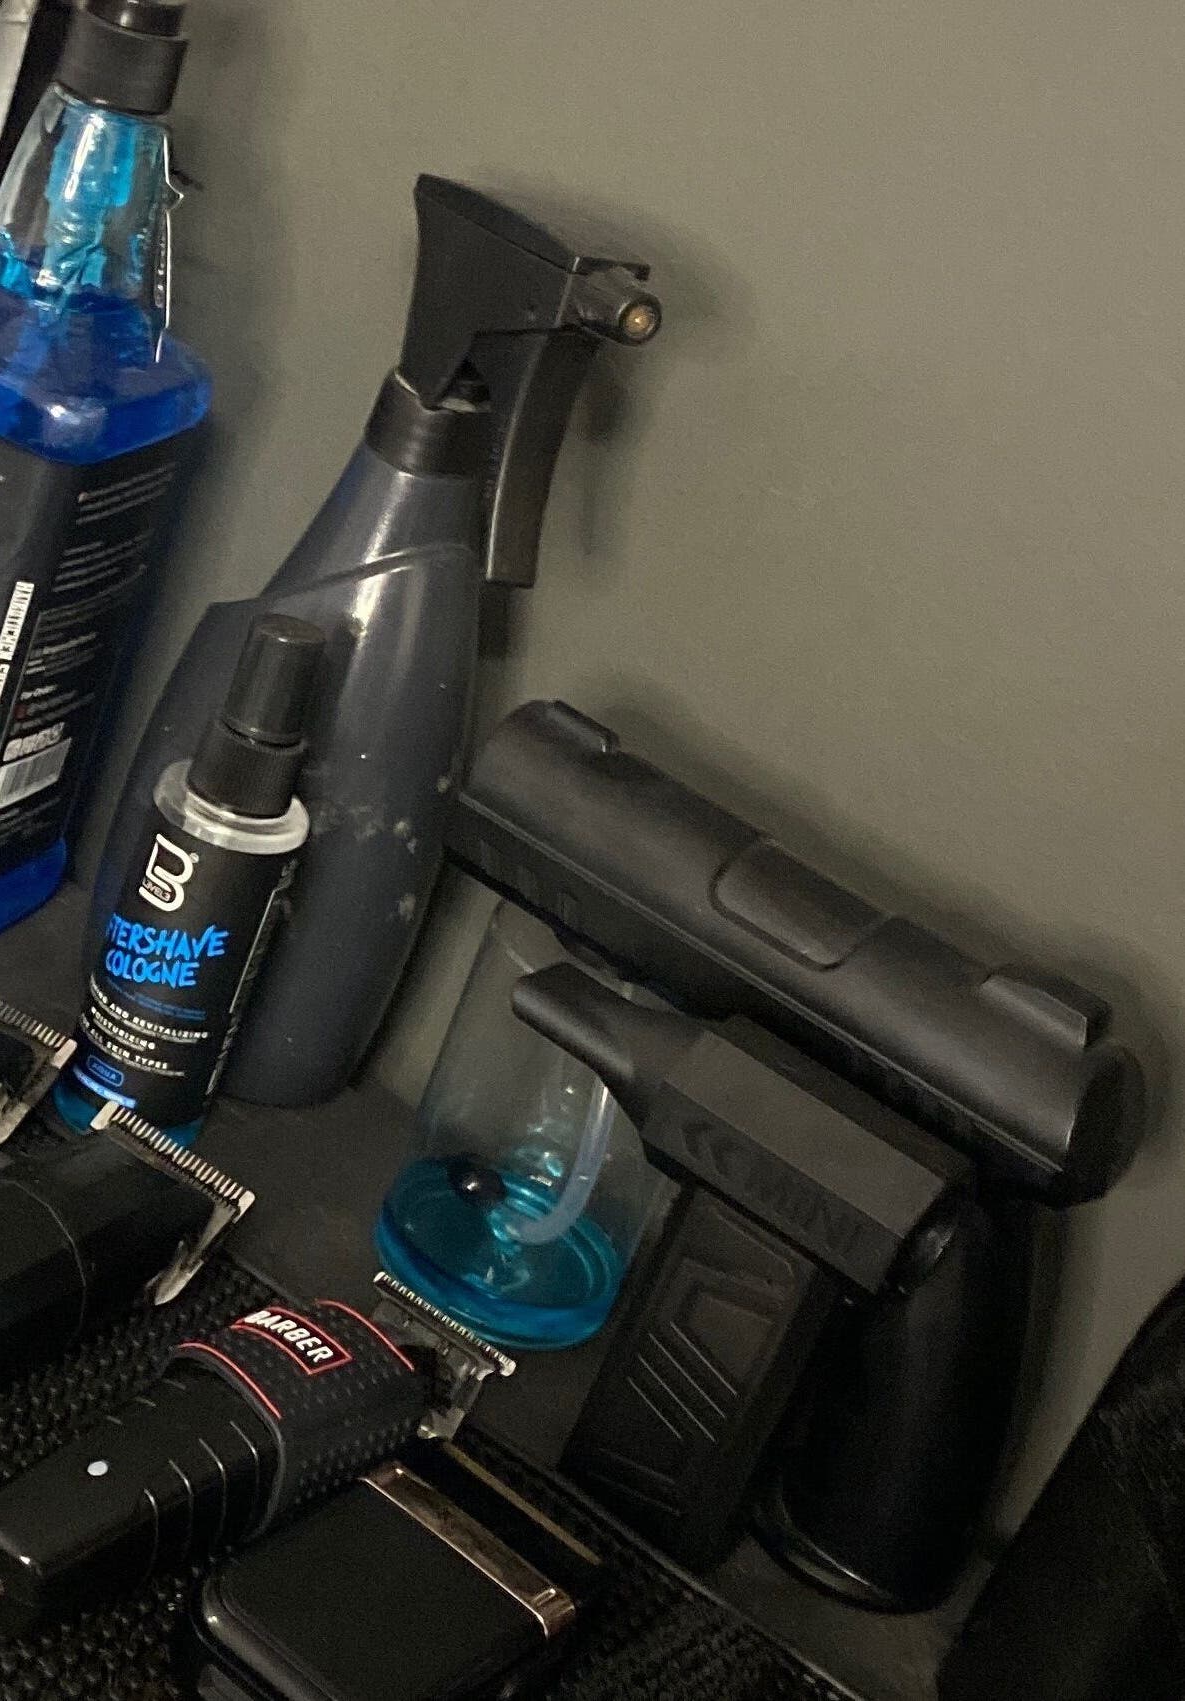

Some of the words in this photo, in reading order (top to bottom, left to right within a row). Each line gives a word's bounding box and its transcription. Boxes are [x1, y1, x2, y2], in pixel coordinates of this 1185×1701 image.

[105, 911, 230, 961] TERSHAVE
[105, 948, 200, 989] COLOGNE
[109, 1003, 130, 1019] AND
[244, 1310, 334, 1364] BARBER
